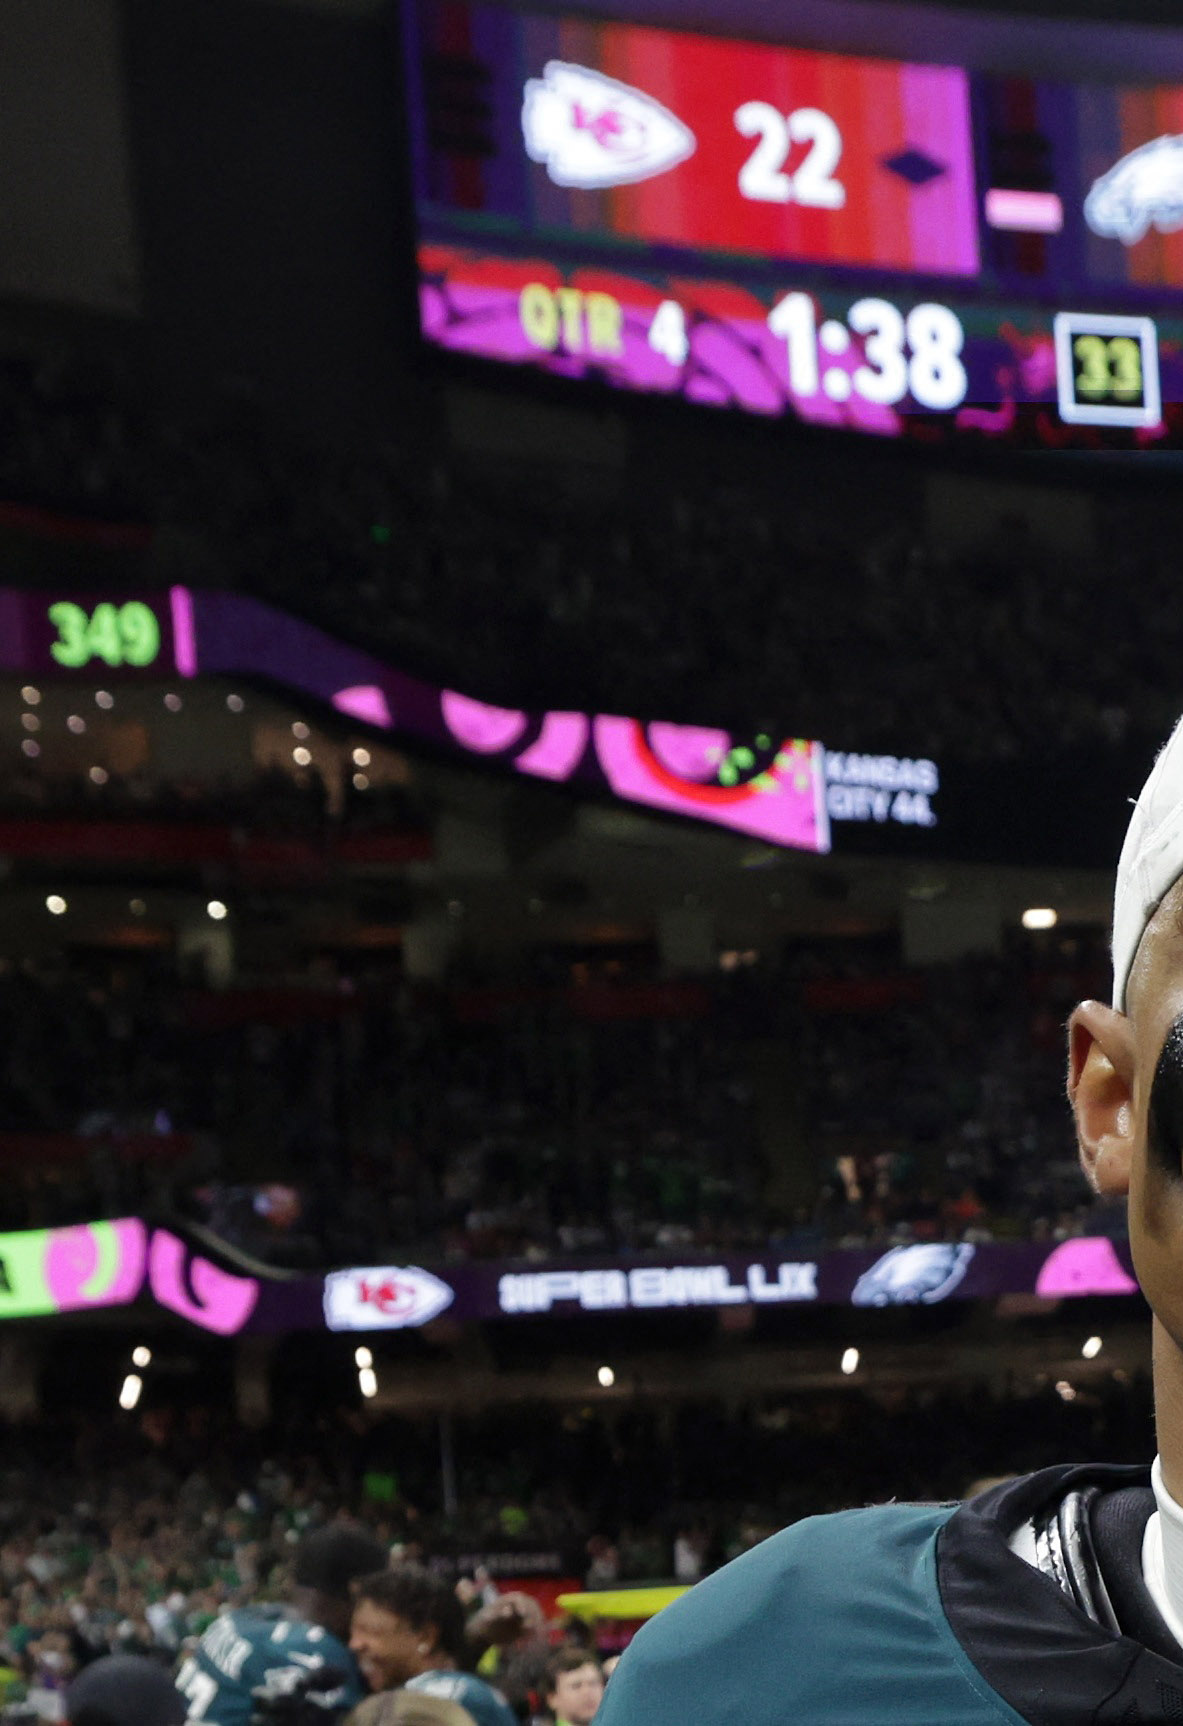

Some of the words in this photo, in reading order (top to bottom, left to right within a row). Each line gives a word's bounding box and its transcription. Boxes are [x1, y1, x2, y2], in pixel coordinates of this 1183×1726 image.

[733, 101, 846, 210] 22
[648, 299, 690, 367] 4
[769, 291, 968, 410] 1:38
[1074, 335, 1142, 402] 33
[47, 601, 161, 668] 349
